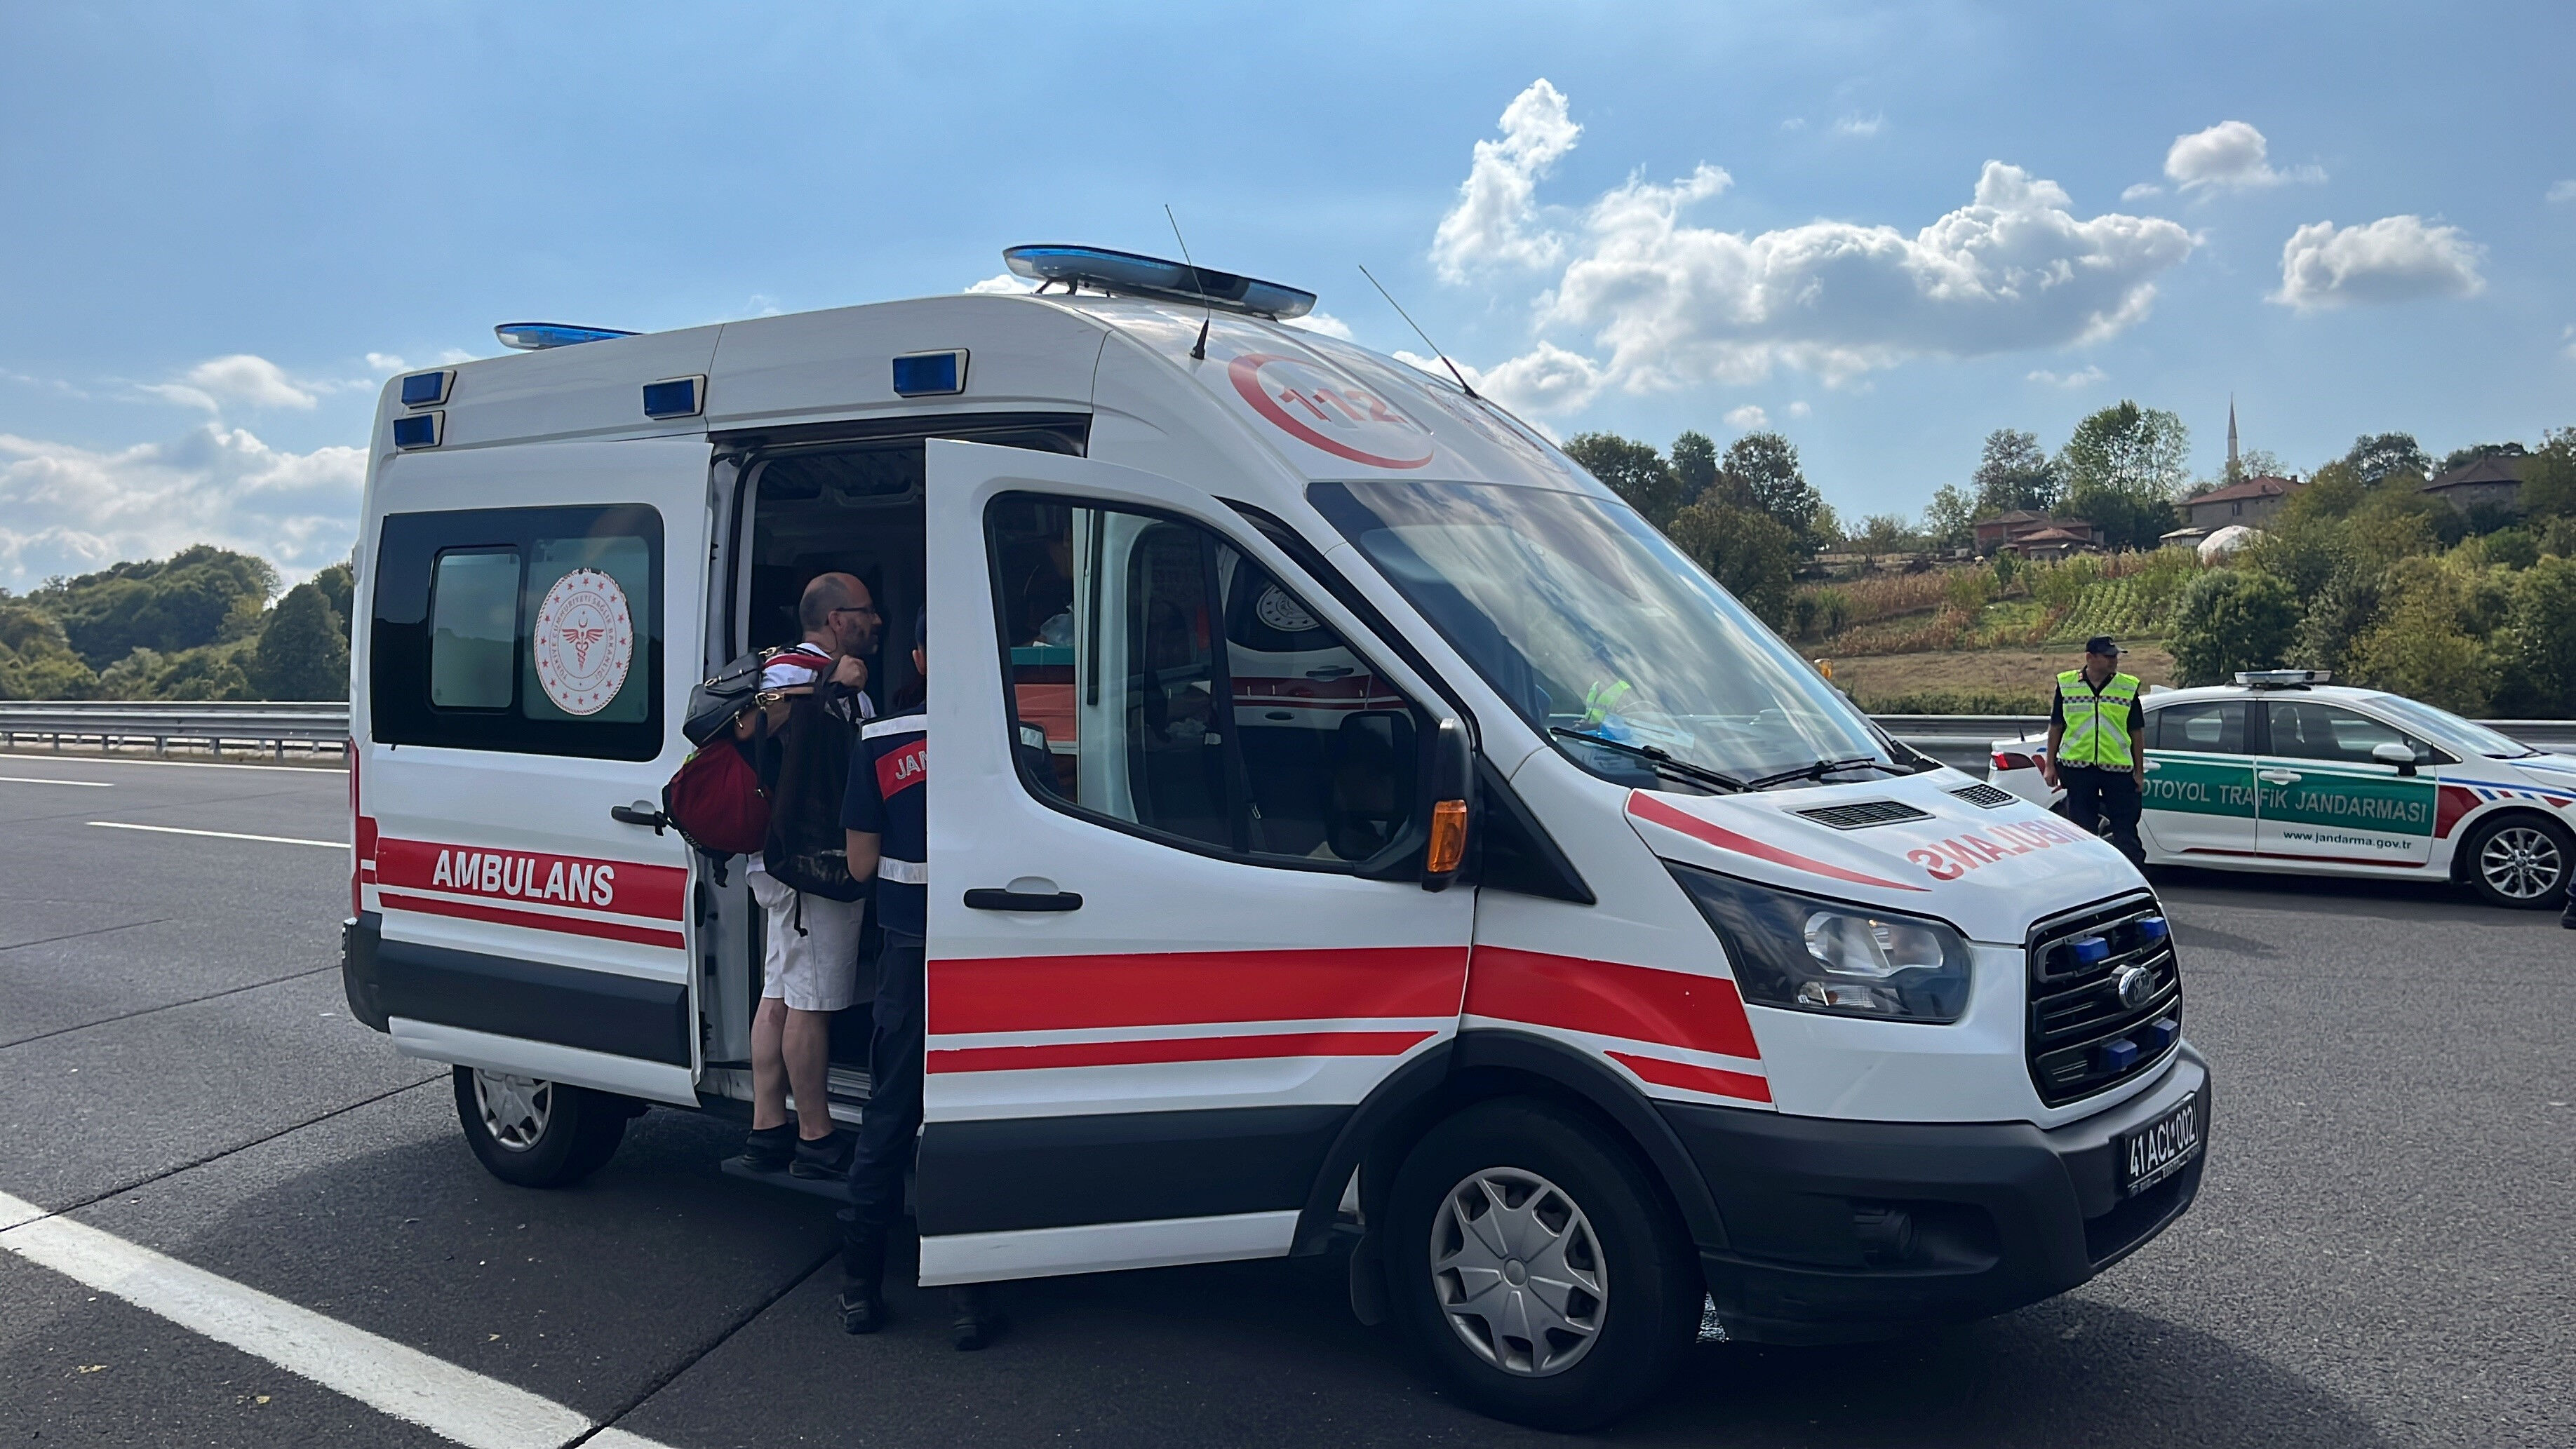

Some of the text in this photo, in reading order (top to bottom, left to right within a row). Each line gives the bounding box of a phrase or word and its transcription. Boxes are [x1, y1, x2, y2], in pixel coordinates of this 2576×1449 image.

[1277, 387, 1409, 424] 112
[2142, 779, 2211, 802] OTOYOL
[2295, 791, 2427, 823] JANDARMASI
[2283, 830, 2412, 850] www.jandarma.gov.tr
[431, 849, 615, 907] AMBULANS
[2130, 1134, 2145, 1177] 41
[2175, 1105, 2195, 1150] 002
